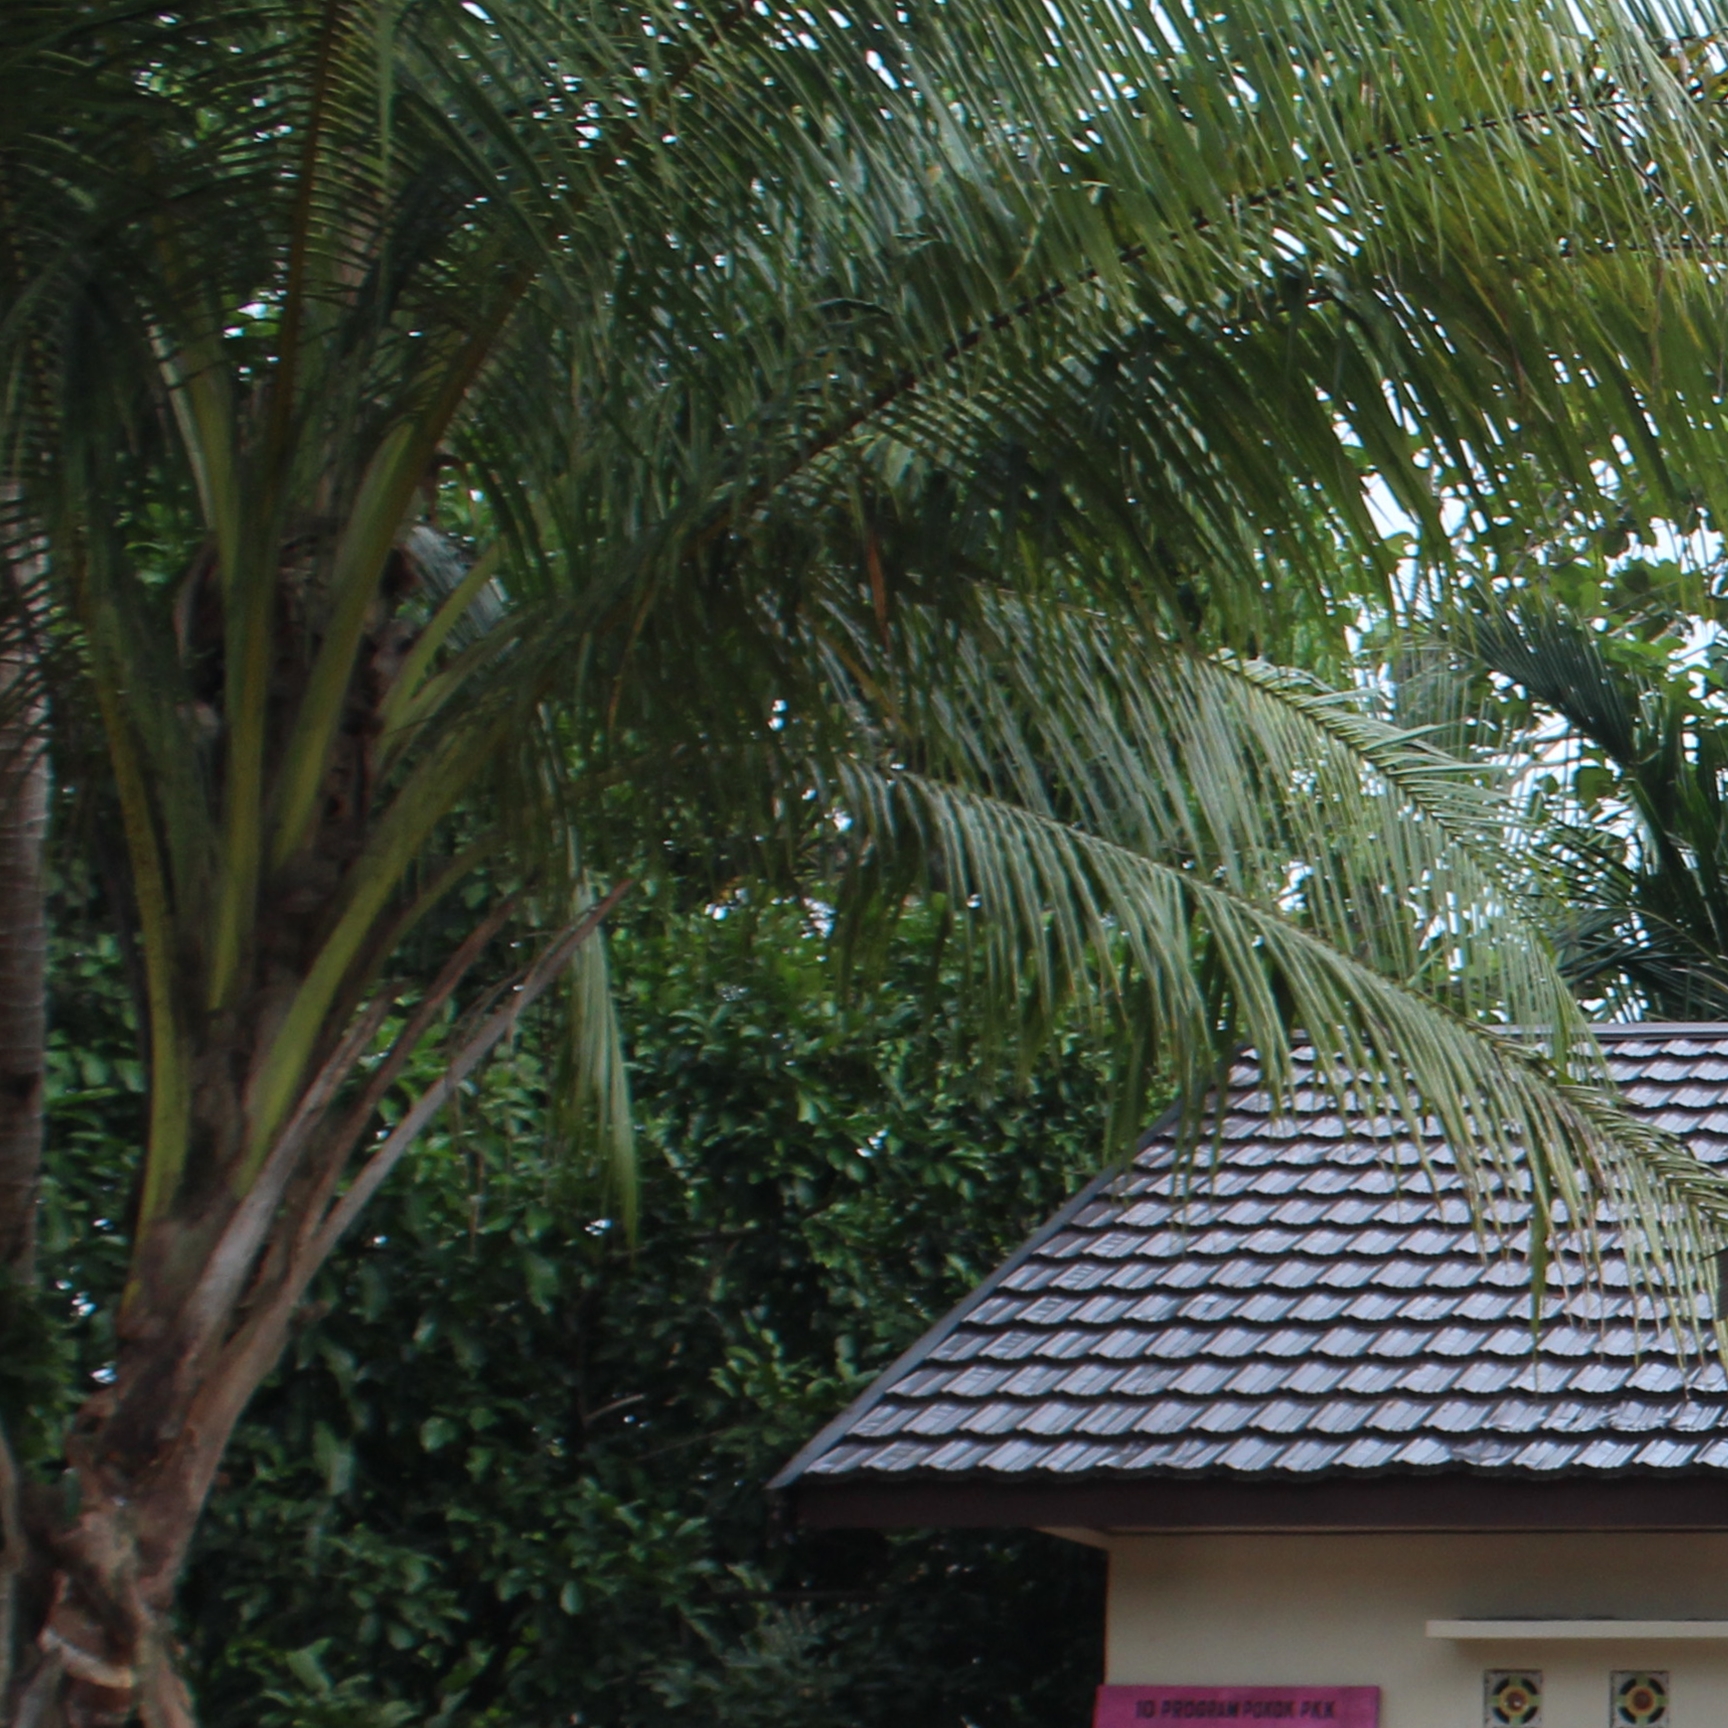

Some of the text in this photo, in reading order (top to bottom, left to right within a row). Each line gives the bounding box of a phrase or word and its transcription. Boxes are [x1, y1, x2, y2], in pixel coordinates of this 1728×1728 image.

[1136, 1700, 1335, 1719] 10 PROGRAM POKOK PKK
